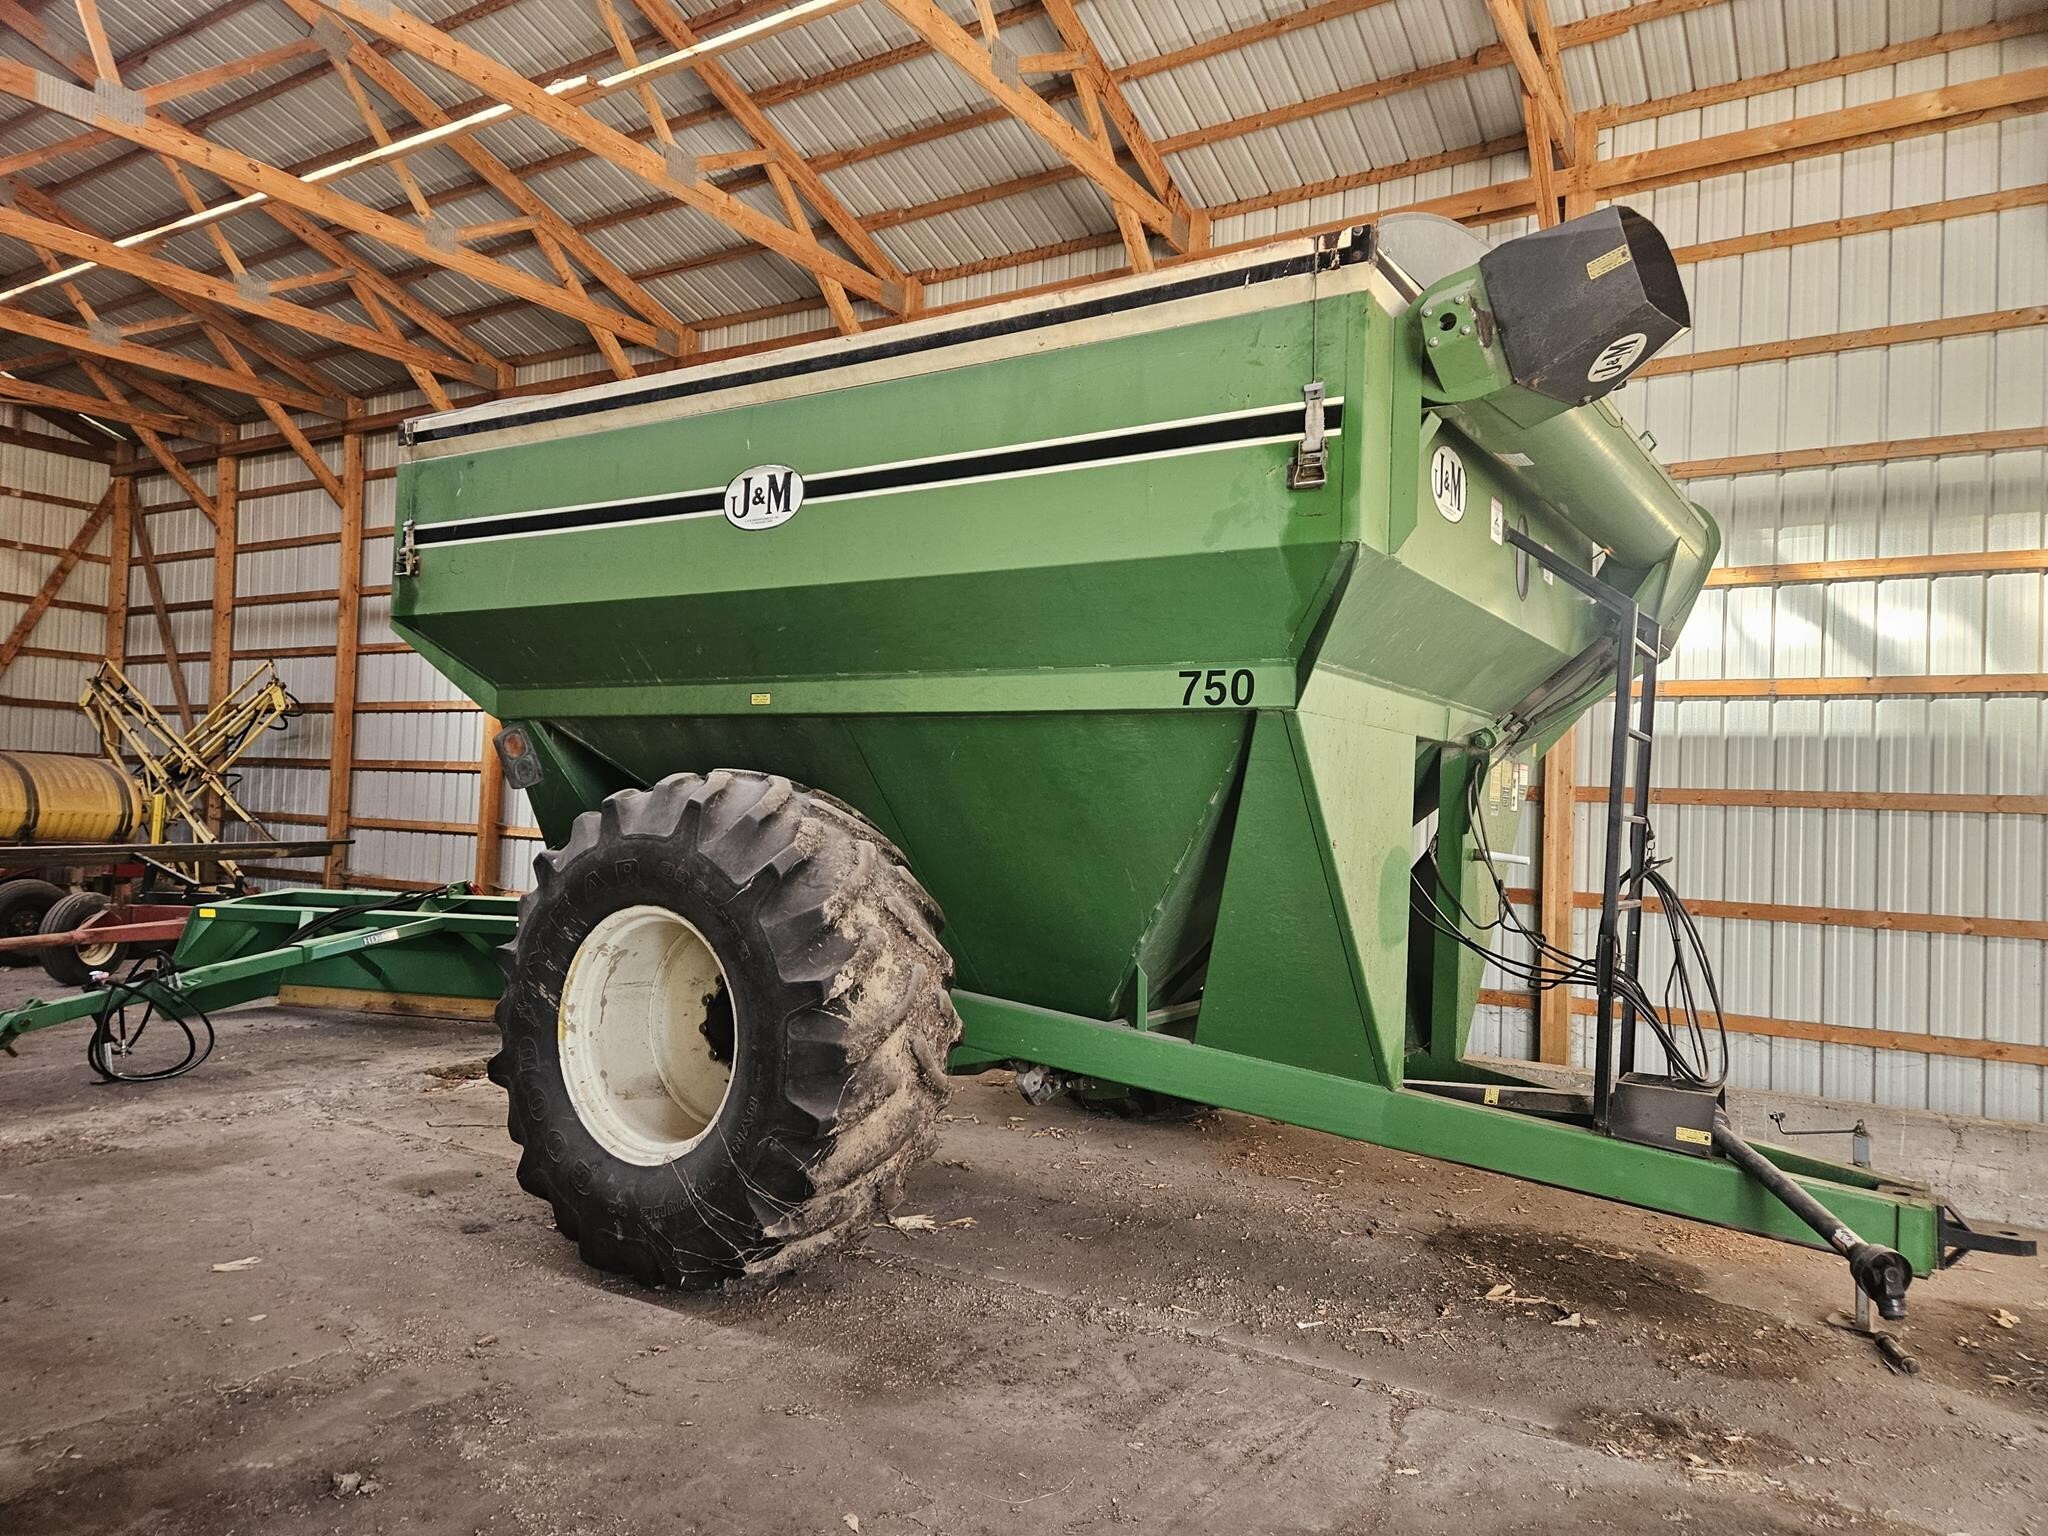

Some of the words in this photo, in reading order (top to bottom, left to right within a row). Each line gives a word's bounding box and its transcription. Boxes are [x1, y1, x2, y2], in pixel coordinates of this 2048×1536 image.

[1593, 337, 1641, 378] J&M
[731, 471, 794, 519] J&M
[1434, 452, 1462, 513] J&M
[1178, 669, 1255, 706] 750
